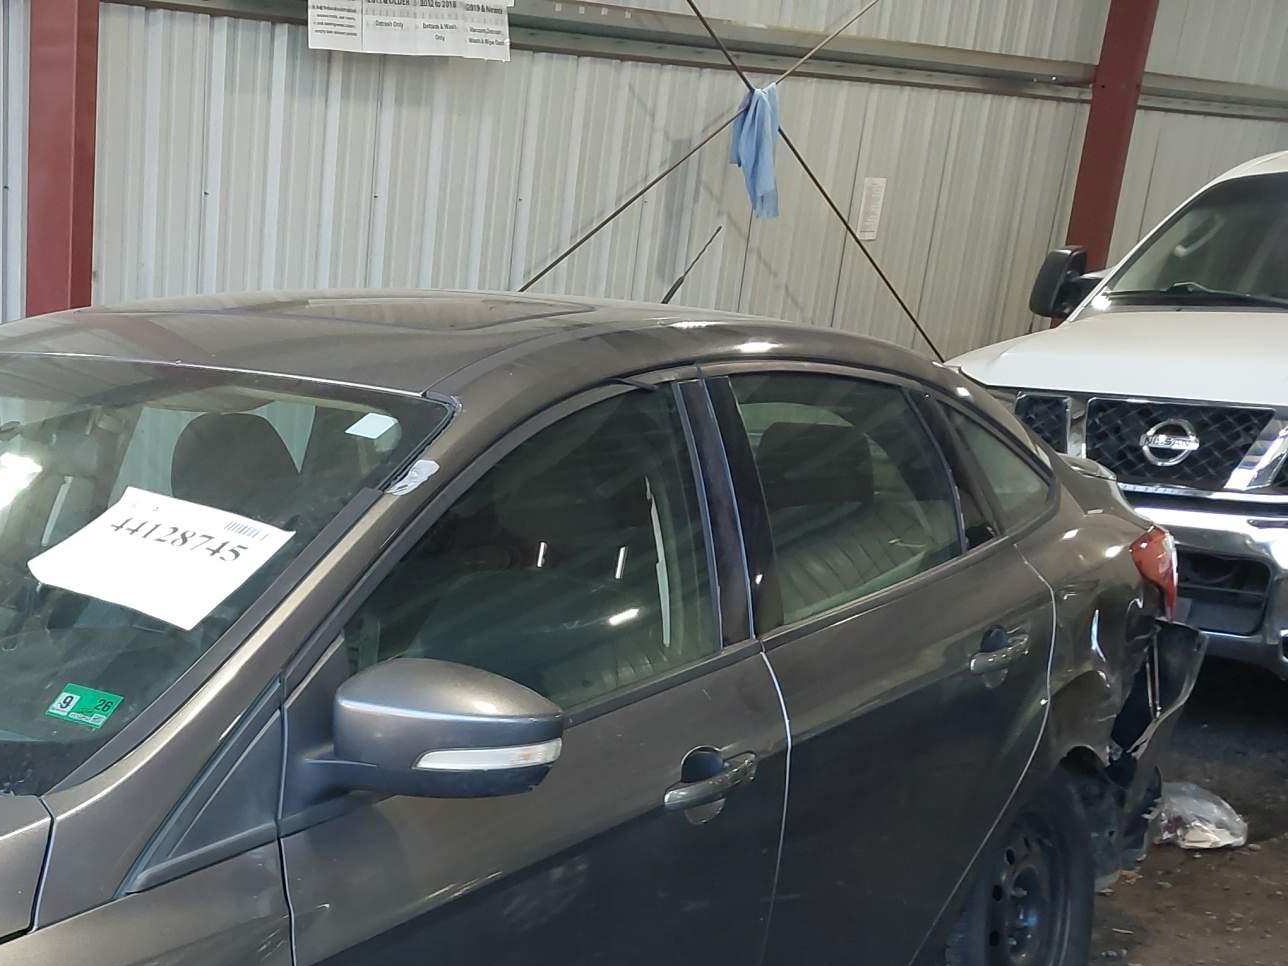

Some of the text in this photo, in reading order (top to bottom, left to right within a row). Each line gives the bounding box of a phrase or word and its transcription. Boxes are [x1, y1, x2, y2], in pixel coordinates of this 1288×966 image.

[110, 518, 249, 561] 44128745
[59, 695, 114, 713] 9 26
